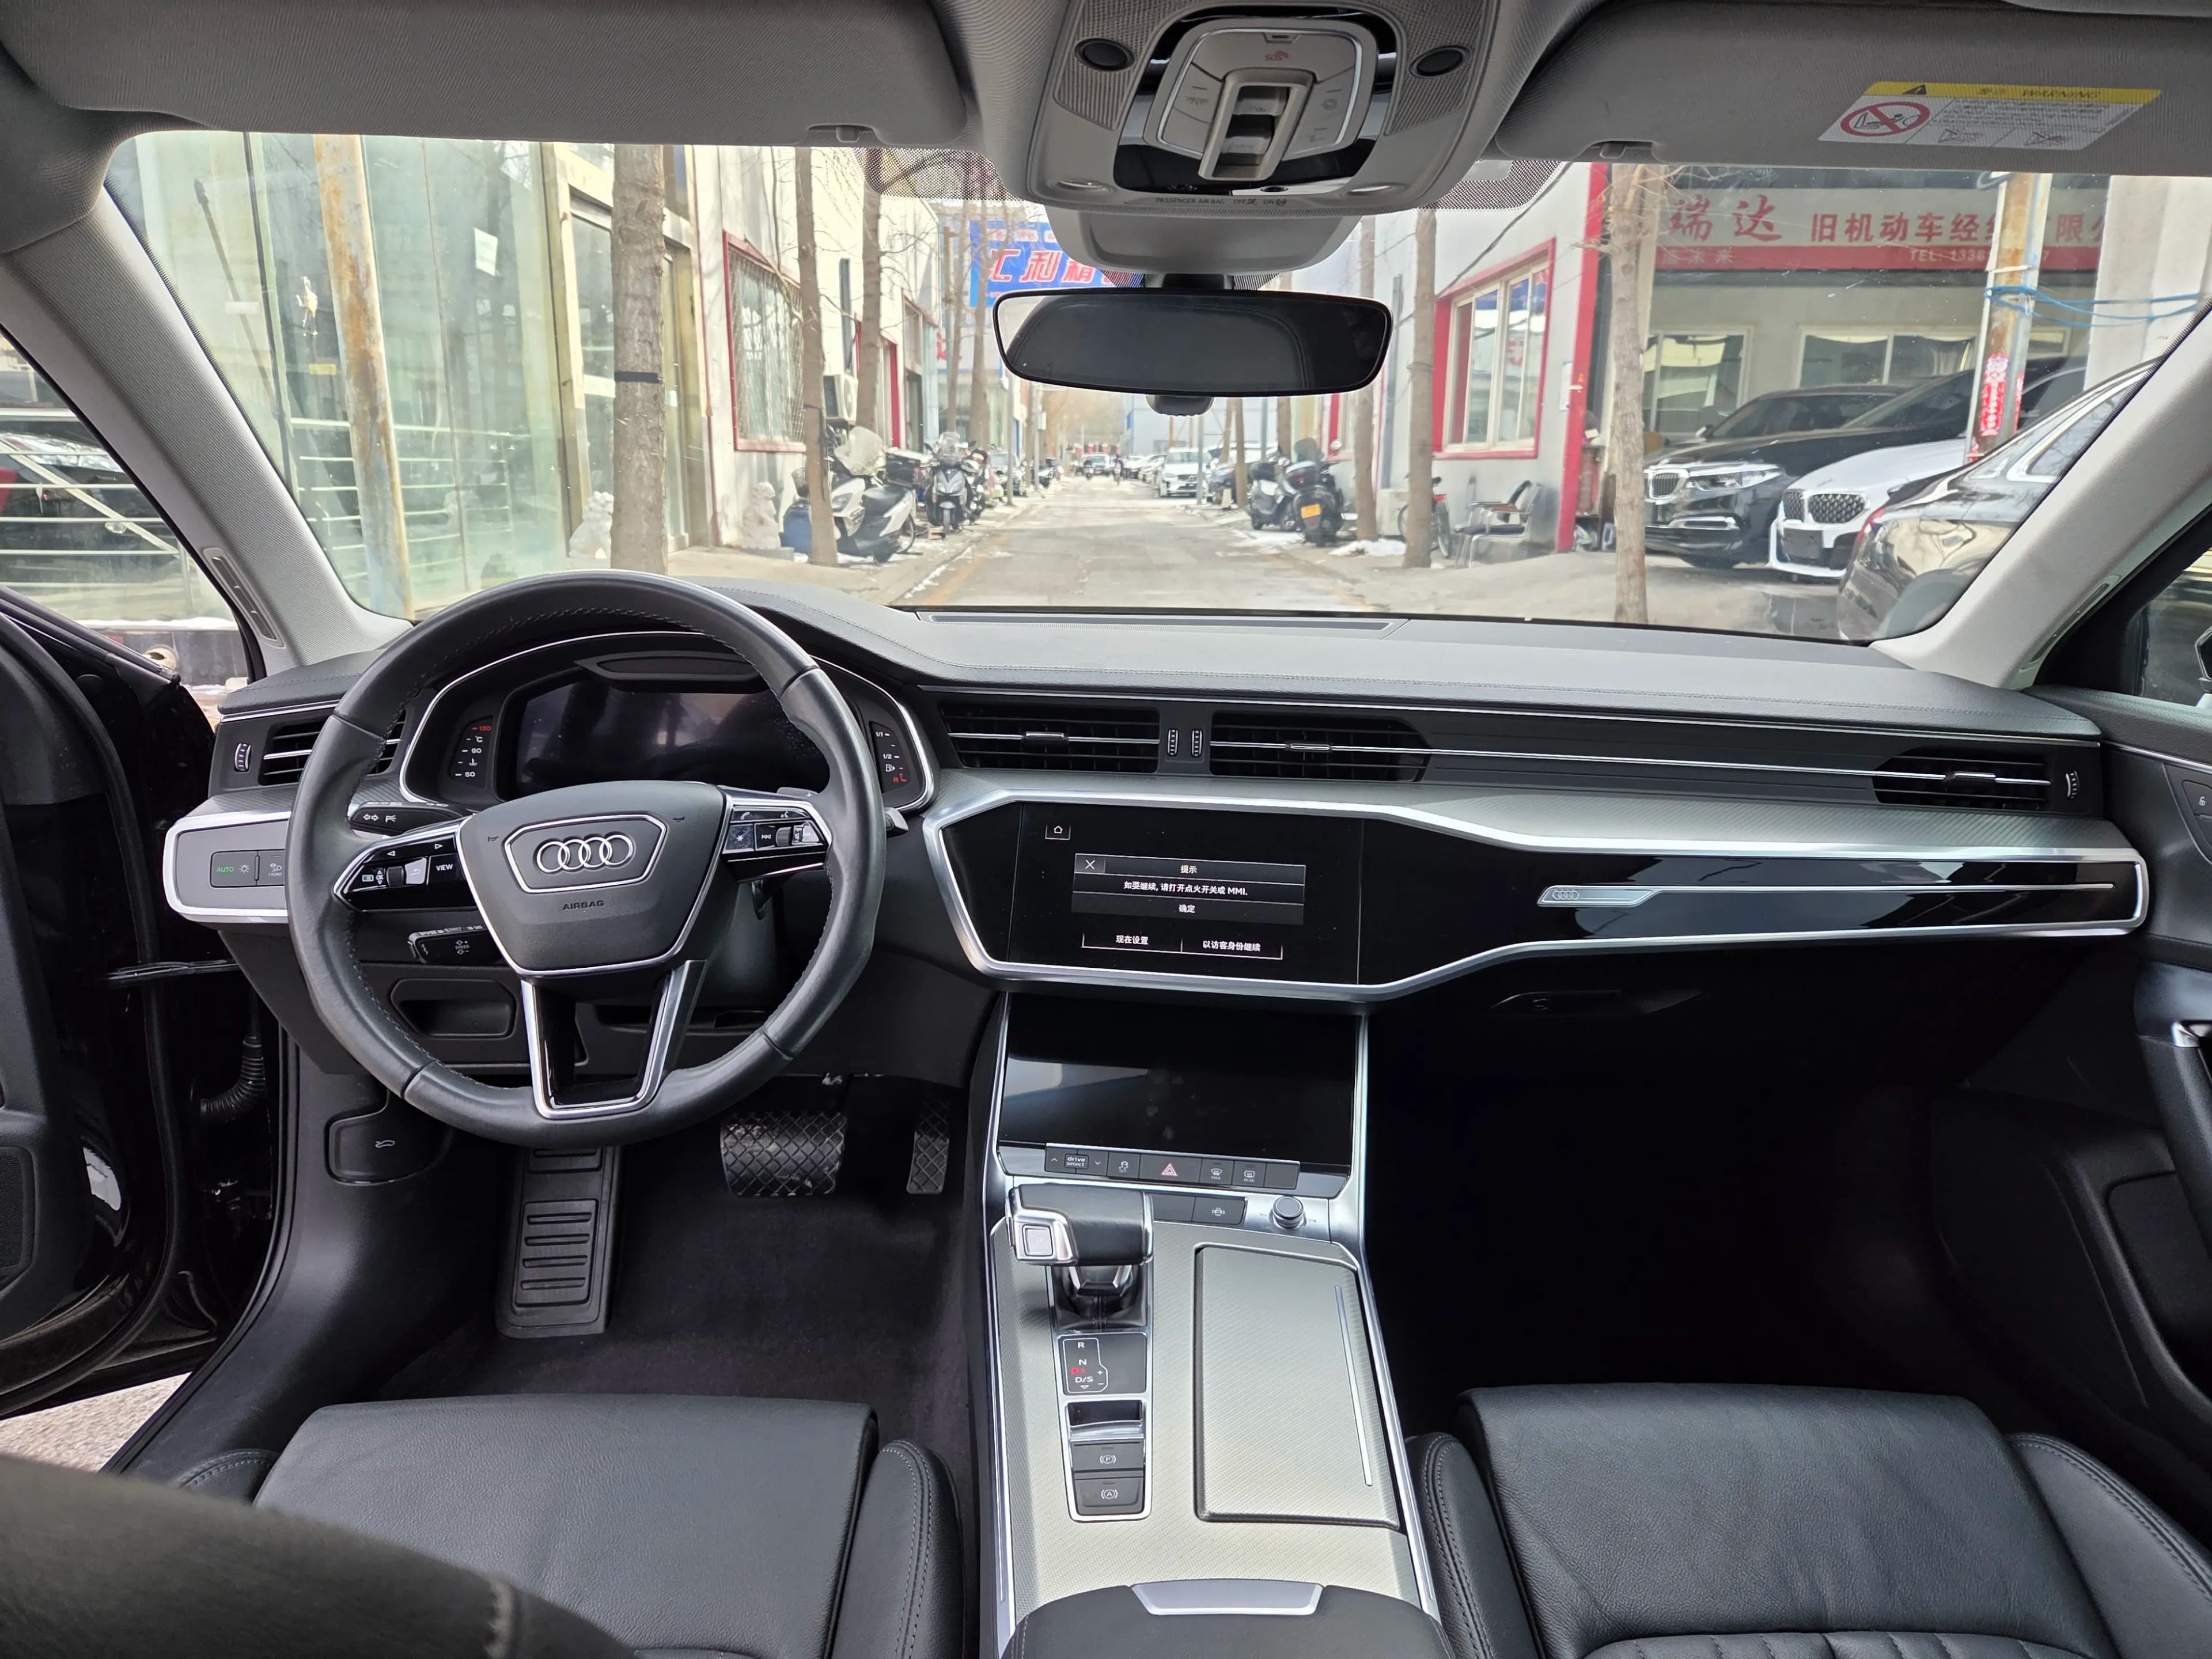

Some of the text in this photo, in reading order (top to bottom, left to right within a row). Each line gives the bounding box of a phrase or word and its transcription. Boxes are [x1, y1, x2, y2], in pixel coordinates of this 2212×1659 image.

[2022, 89, 2101, 99] WARNING
[1668, 194, 1783, 242] 瑞达
[435, 863, 453, 872] VIEW
[1180, 864, 1198, 874] 提示
[562, 899, 605, 911] AIRBAG
[1179, 904, 1196, 914] 确定
[1115, 934, 1149, 946] 现在设置
[1202, 940, 1262, 953] 以访客身份继续
